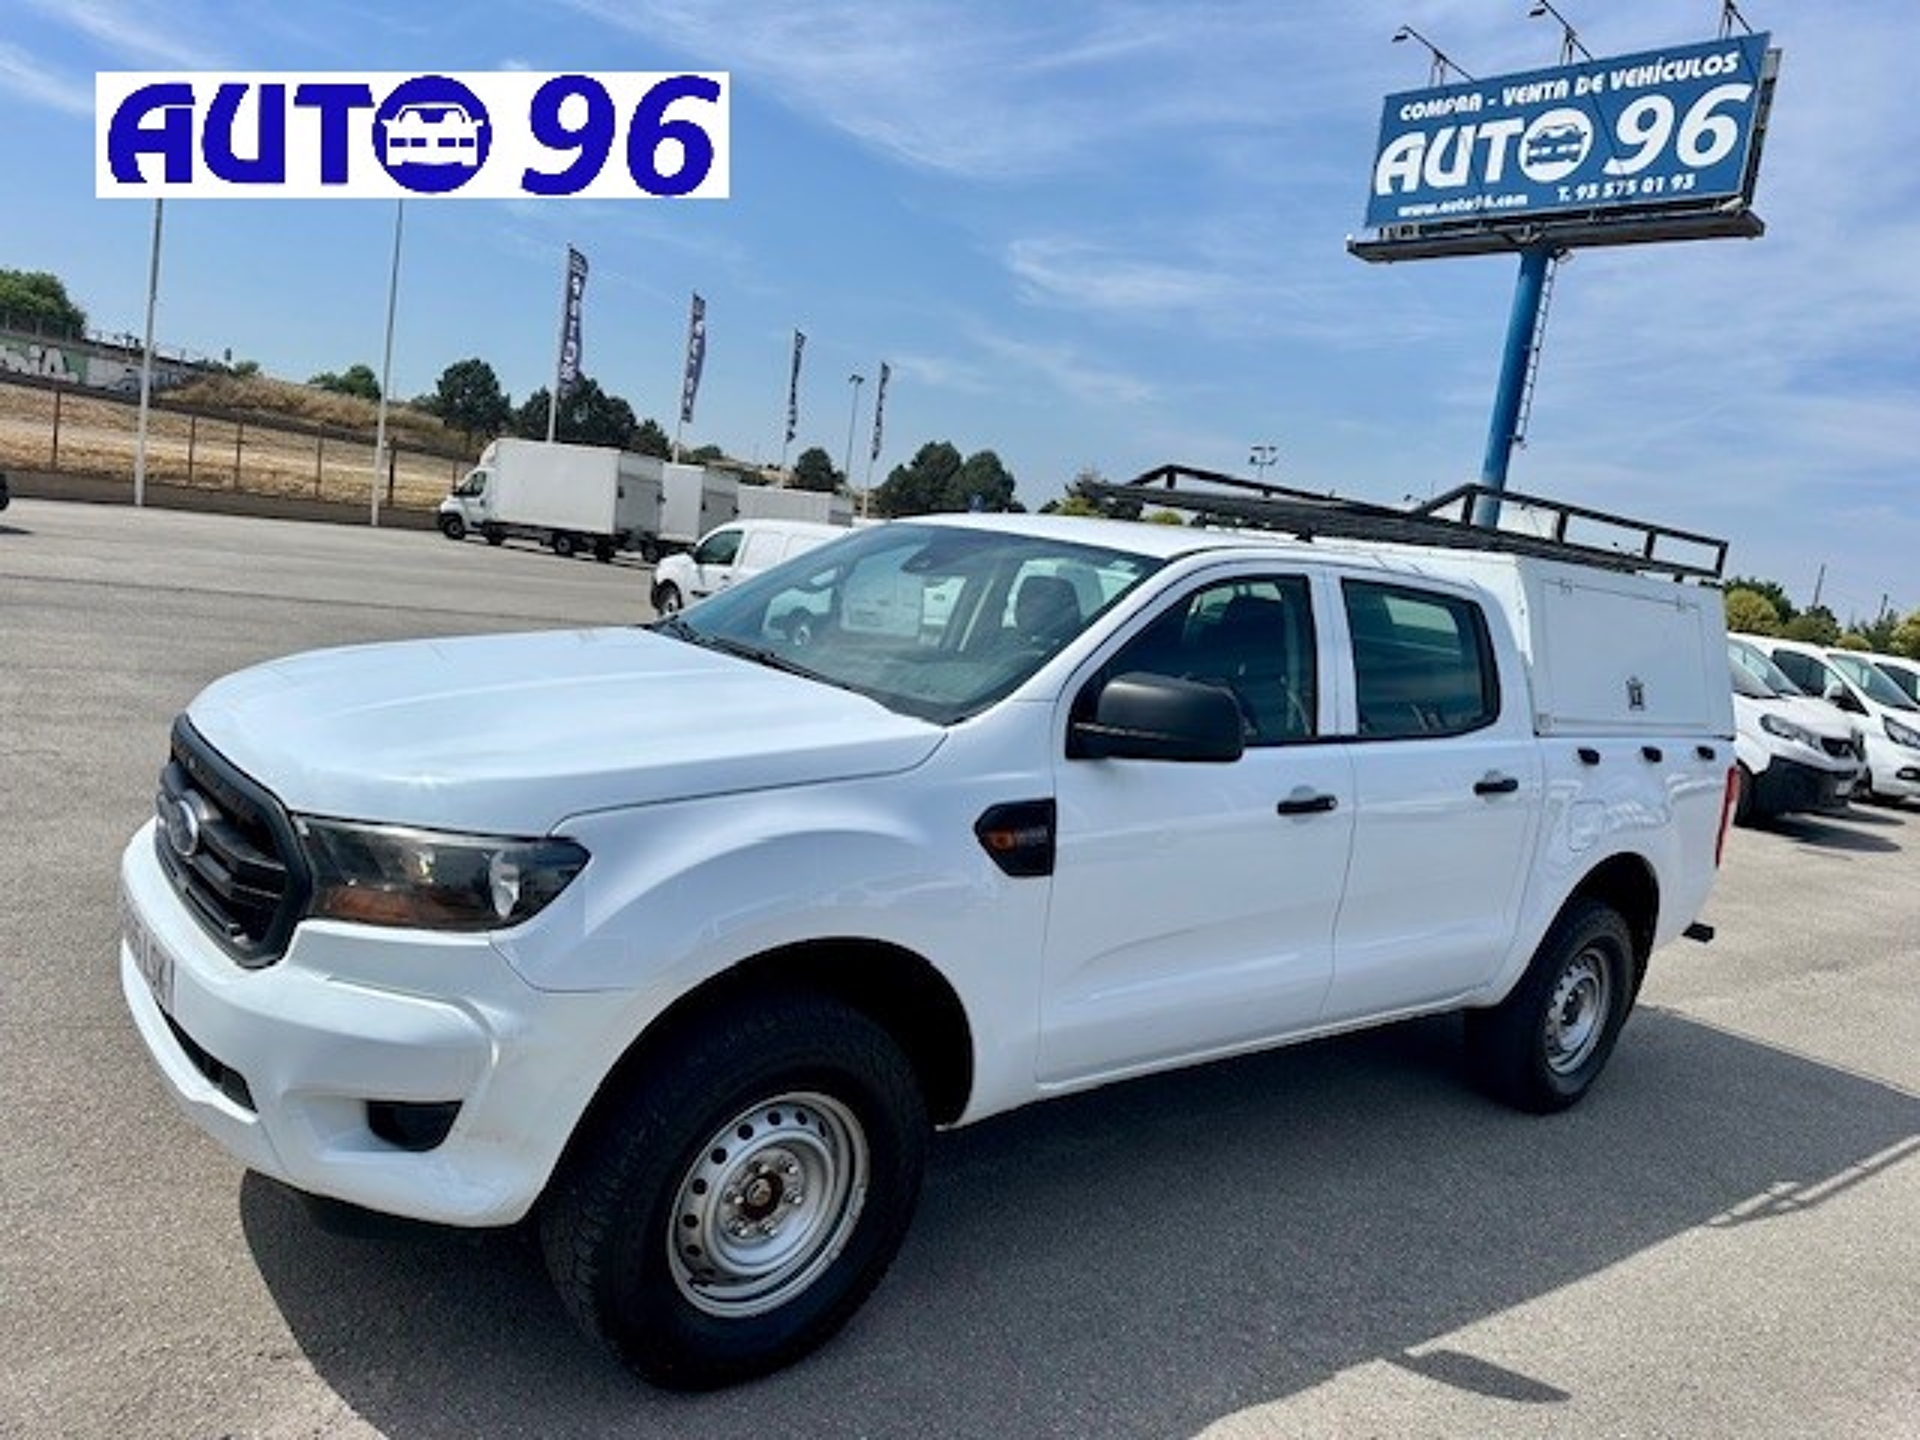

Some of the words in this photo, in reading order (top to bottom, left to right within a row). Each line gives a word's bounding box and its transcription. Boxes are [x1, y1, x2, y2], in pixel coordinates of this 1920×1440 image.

[1400, 93, 1482, 120] COMPRA
[1502, 78, 1569, 107] VENTA
[1574, 74, 1605, 96] DE
[1610, 56, 1739, 90] VEHÍCULOS
[1375, 107, 1593, 195] AUTO
[1602, 84, 1753, 175] 96
